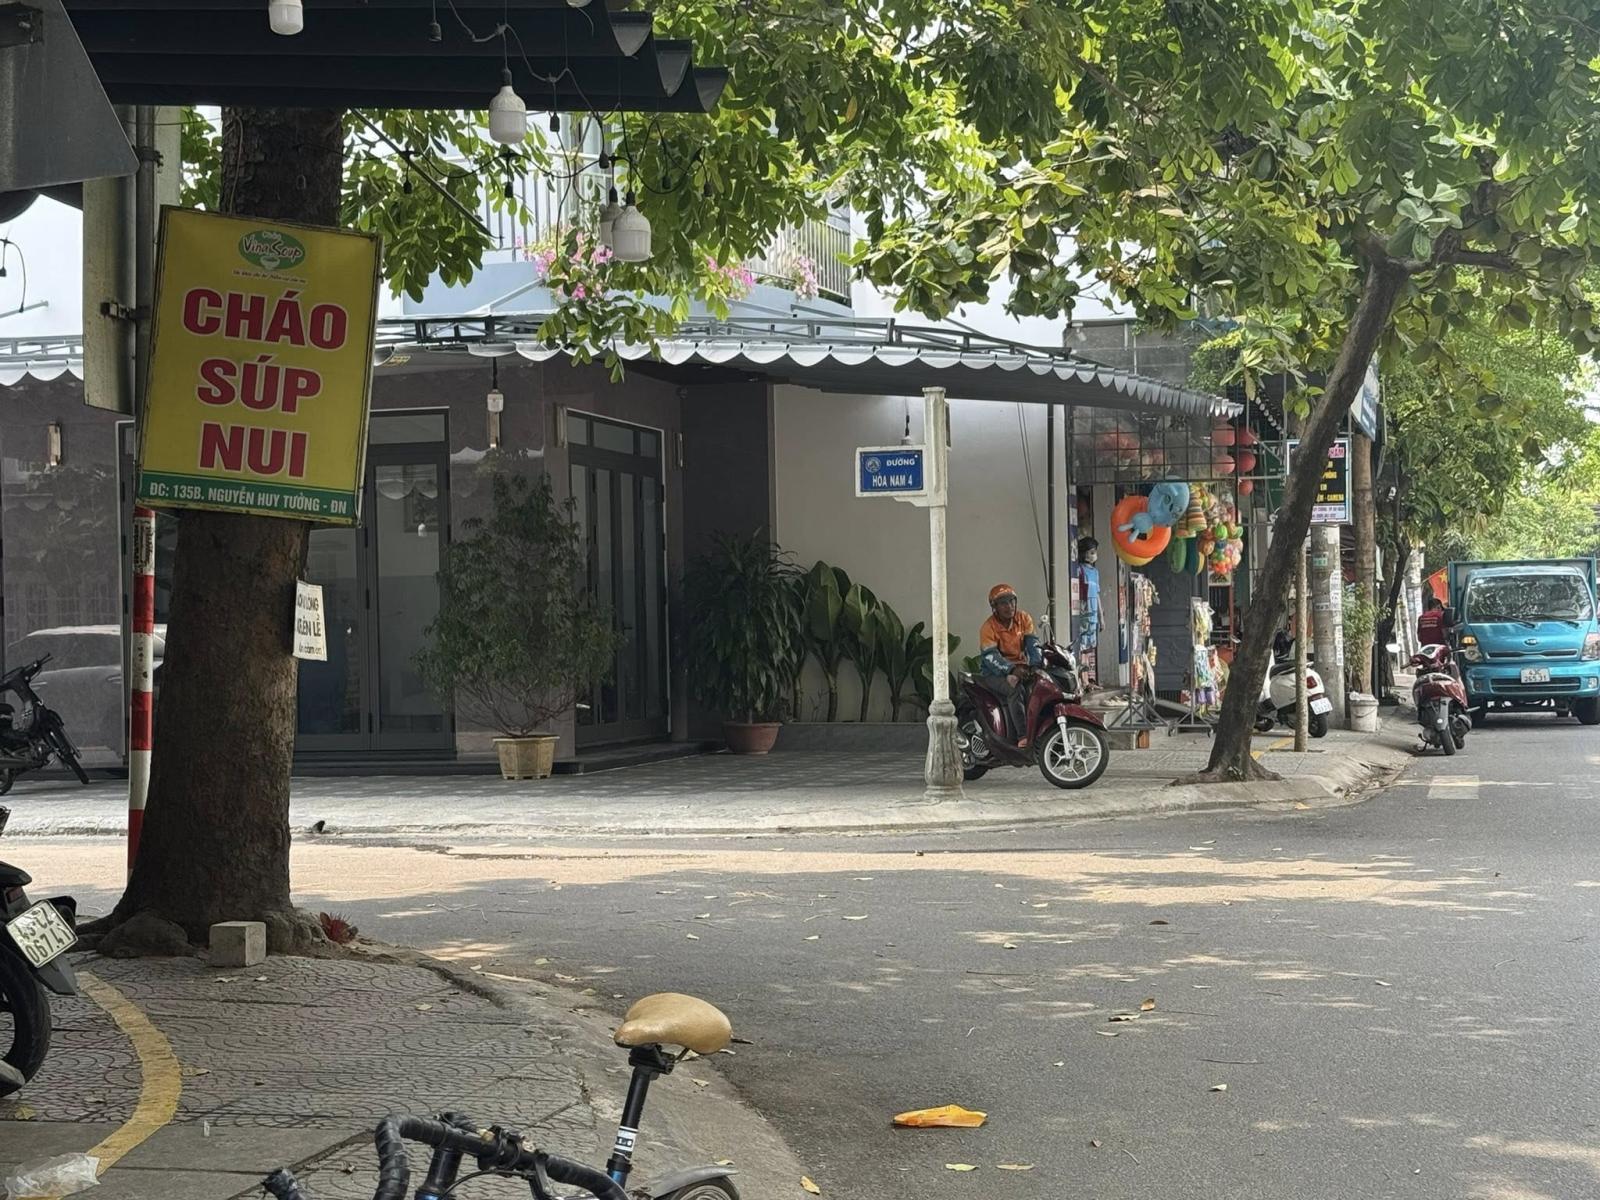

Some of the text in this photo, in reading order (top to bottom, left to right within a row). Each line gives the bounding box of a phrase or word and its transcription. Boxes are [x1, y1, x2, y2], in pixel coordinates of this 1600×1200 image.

[182, 287, 348, 351] CHÁO
[196, 354, 322, 415] SÚP
[198, 421, 309, 479] NUI
[150, 482, 169, 497] ĐC:
[257, 493, 279, 507] HUY
[330, 501, 347, 514] ĐN
[890, 475, 906, 487] NAM
[907, 474, 913, 486] 4
